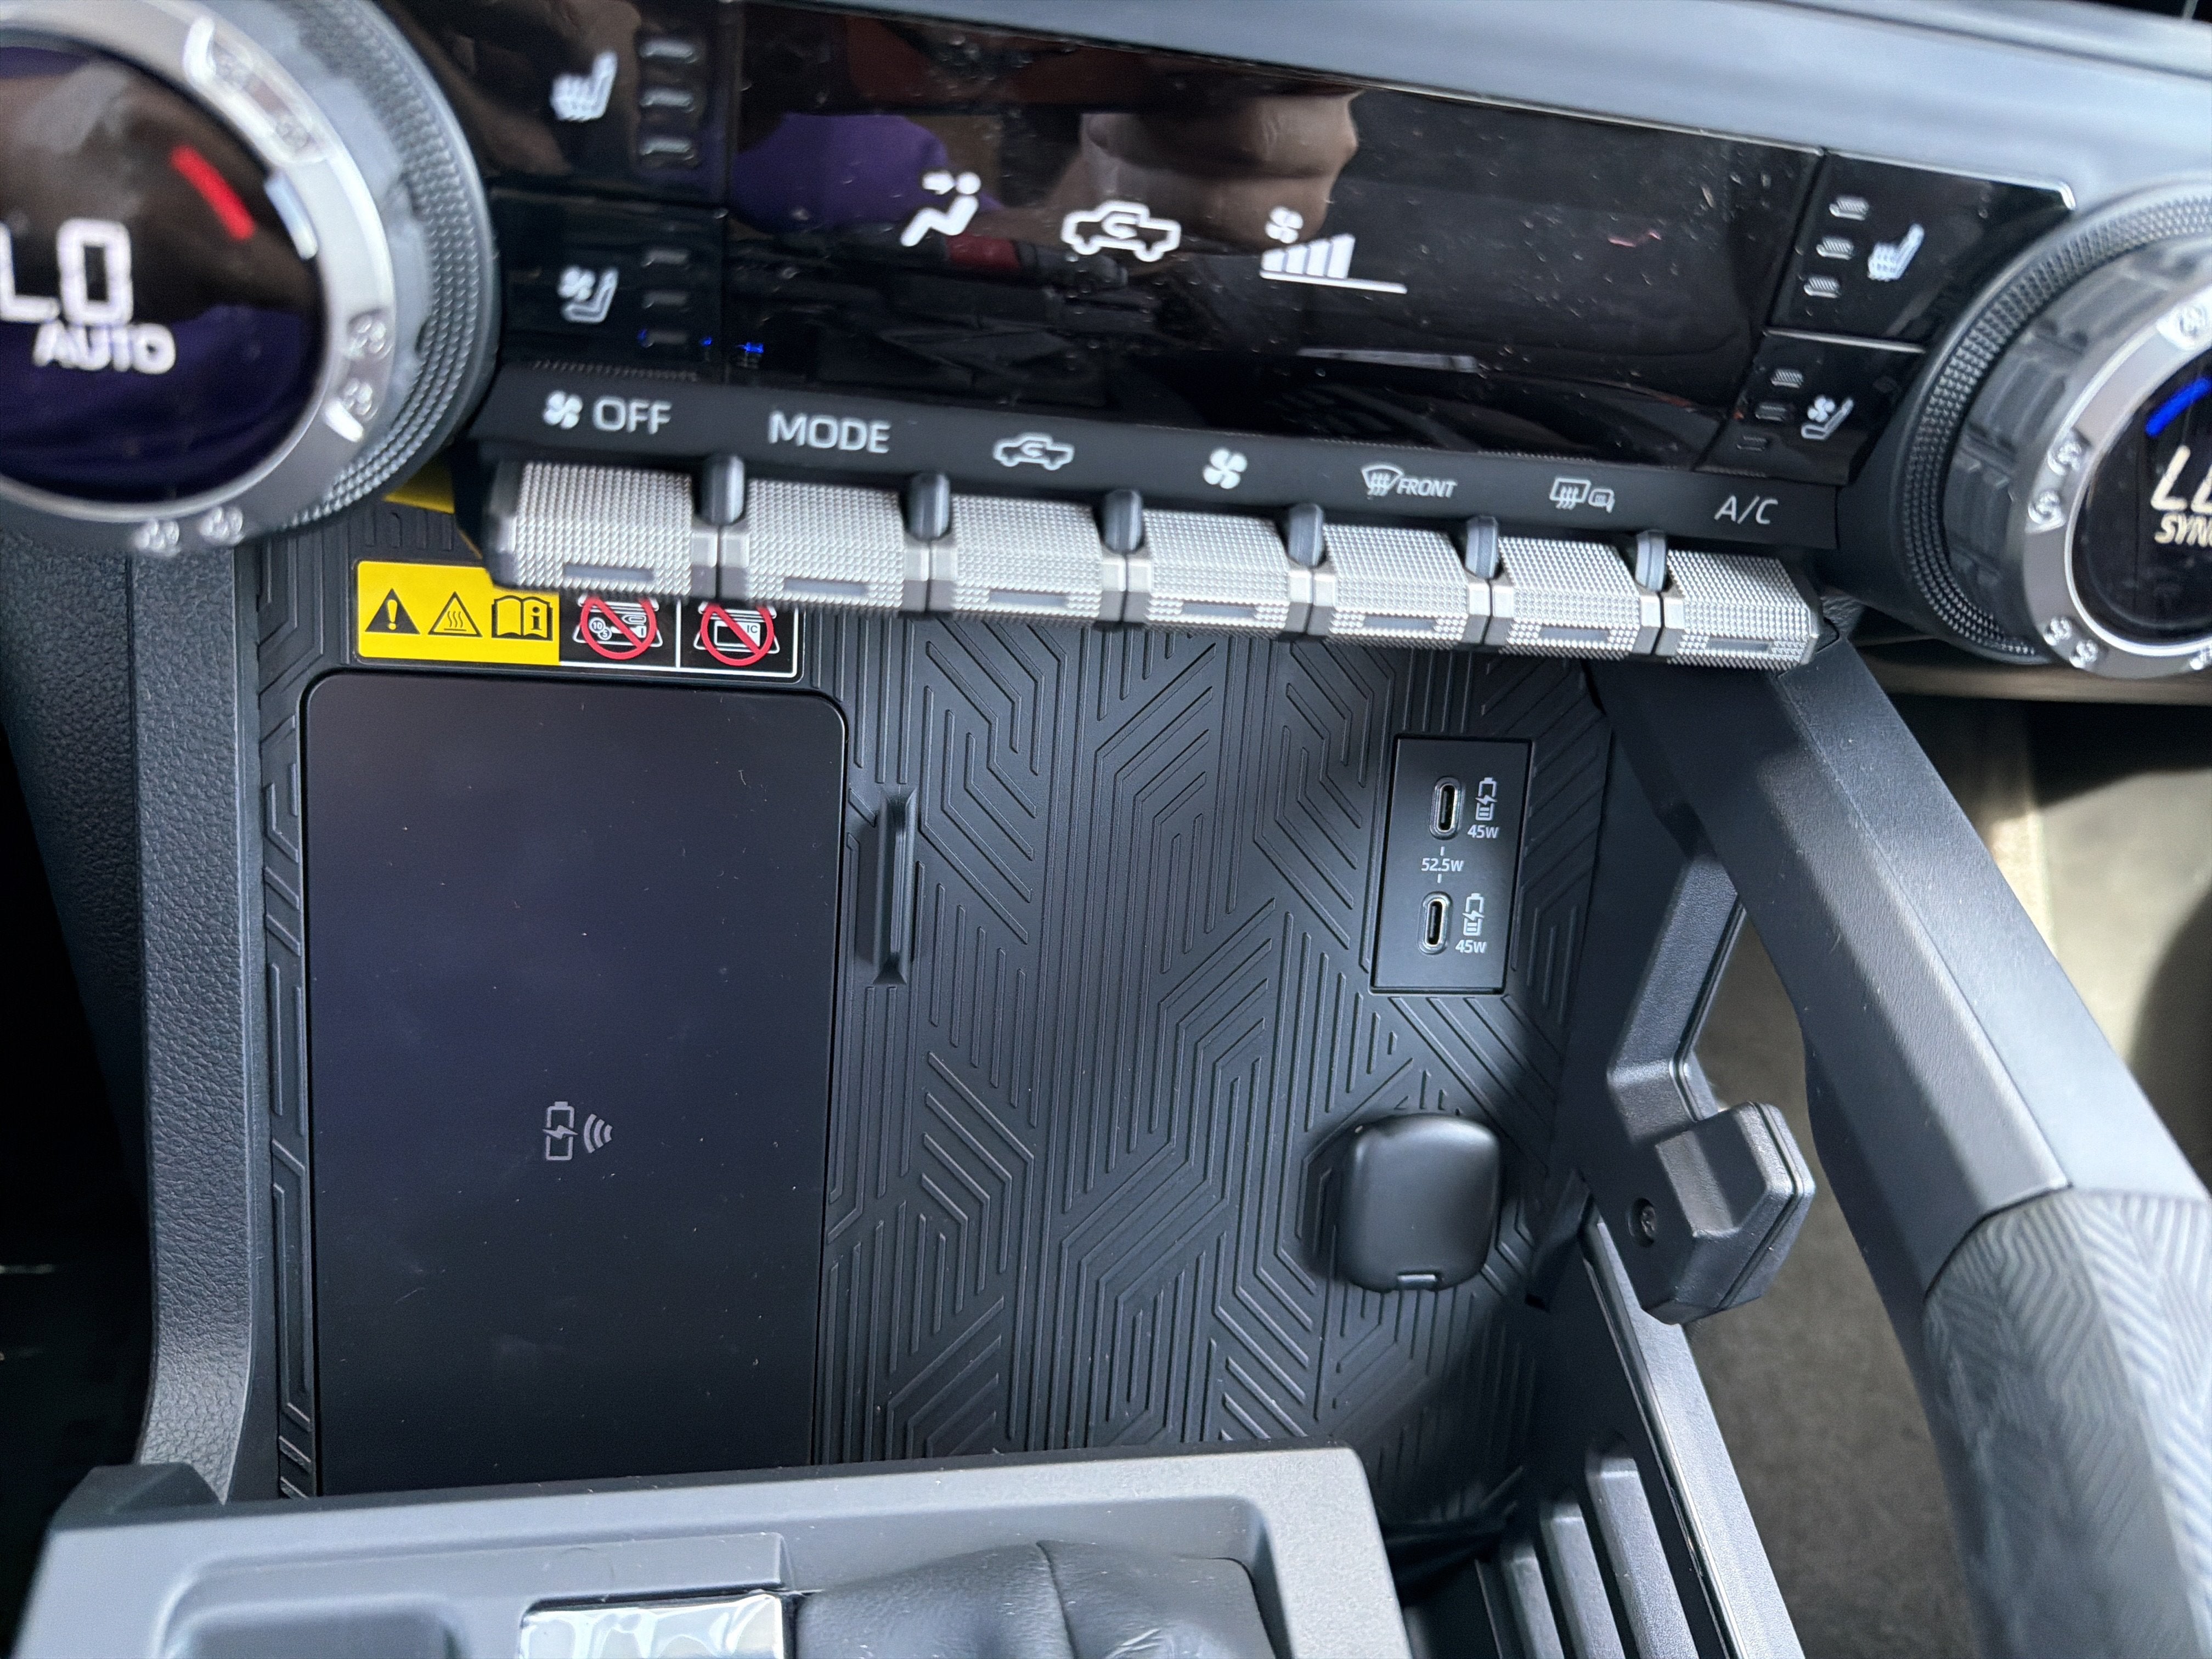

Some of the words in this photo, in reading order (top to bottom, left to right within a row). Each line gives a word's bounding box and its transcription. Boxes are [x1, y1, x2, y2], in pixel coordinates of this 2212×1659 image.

[33, 320, 176, 374] AUTO
[592, 396, 672, 434] OFF
[769, 411, 891, 454] MODE
[1396, 477, 1458, 498] FRONT
[1714, 495, 1779, 525] A/C
[592, 621, 602, 629] 10
[747, 625, 758, 634] IC
[1467, 825, 1499, 839] 45W
[1421, 857, 1464, 872] 52.5W
[1455, 939, 1487, 953] 45W
